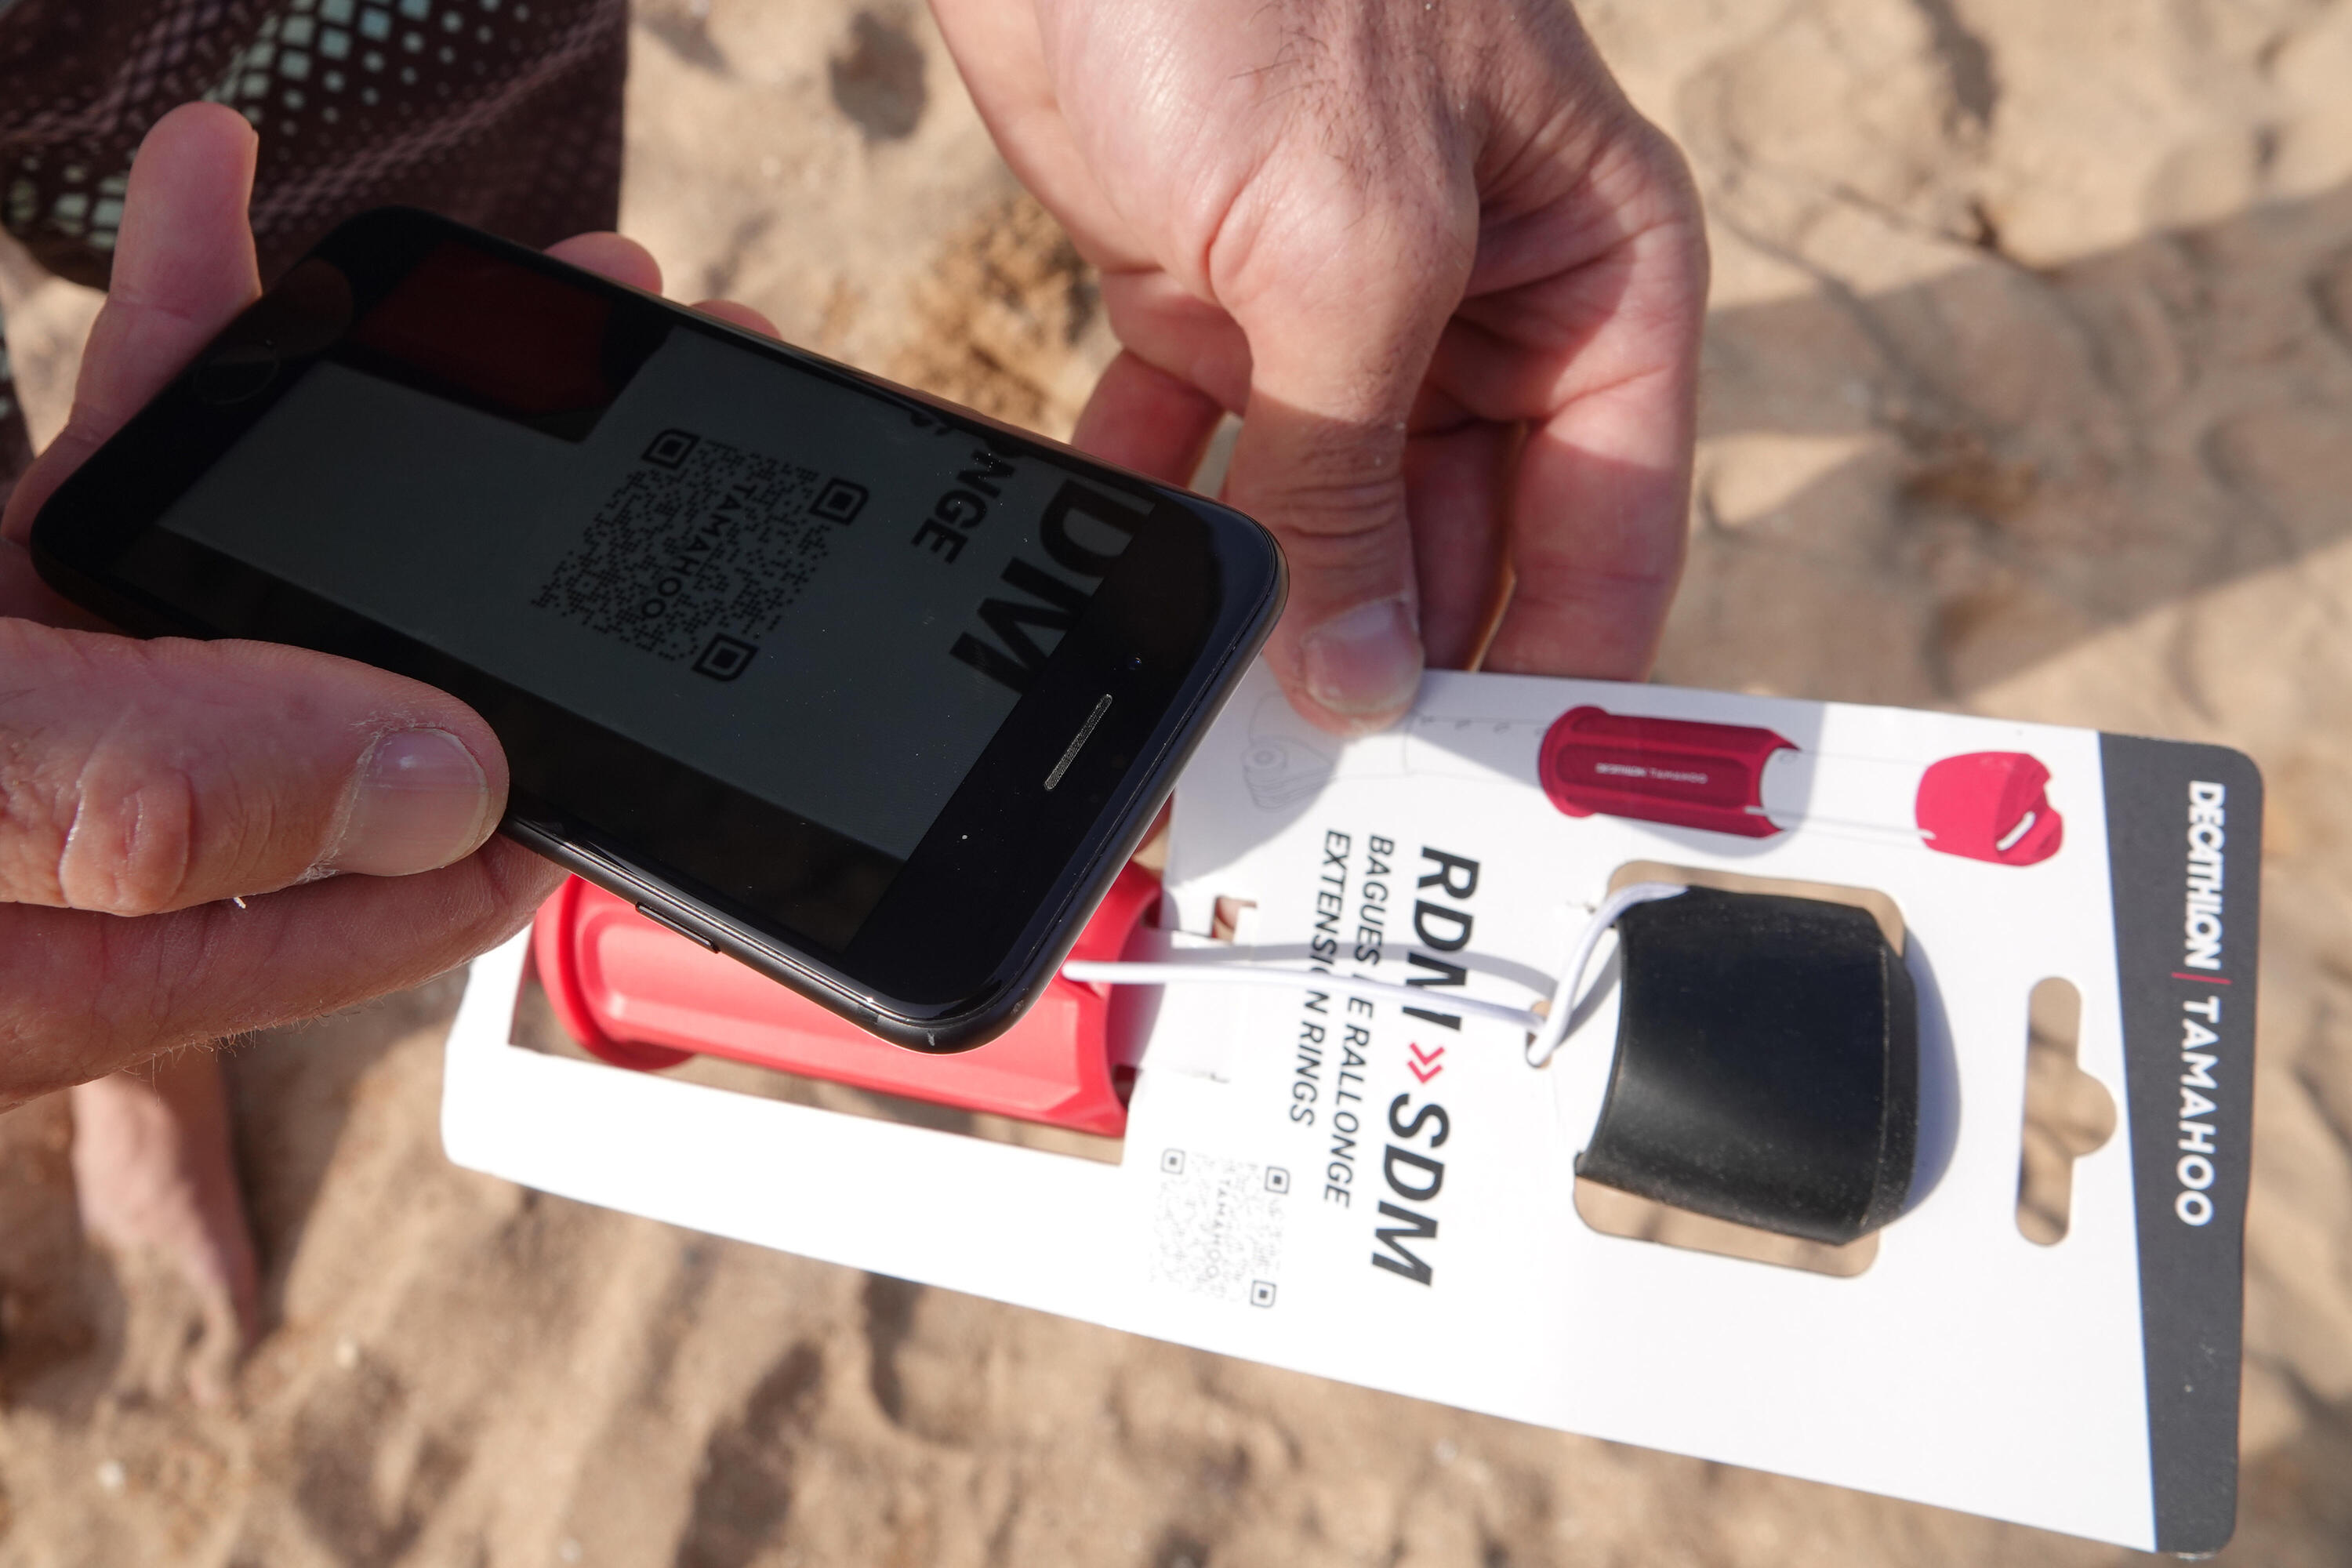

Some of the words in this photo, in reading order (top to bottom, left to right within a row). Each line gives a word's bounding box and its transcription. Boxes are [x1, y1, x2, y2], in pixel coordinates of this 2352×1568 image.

[641, 484, 757, 619] TAMAHOO
[1356, 833, 1394, 967] BAGUES
[1403, 846, 1480, 1031] RDM
[2185, 781, 2224, 971] DECATHLON
[1290, 1021, 1325, 1126] RINGS
[1325, 1020, 1370, 1207] RALLONGE
[2176, 996, 2220, 1226] TAMAHOO
[1372, 1093, 1450, 1287] SDM
